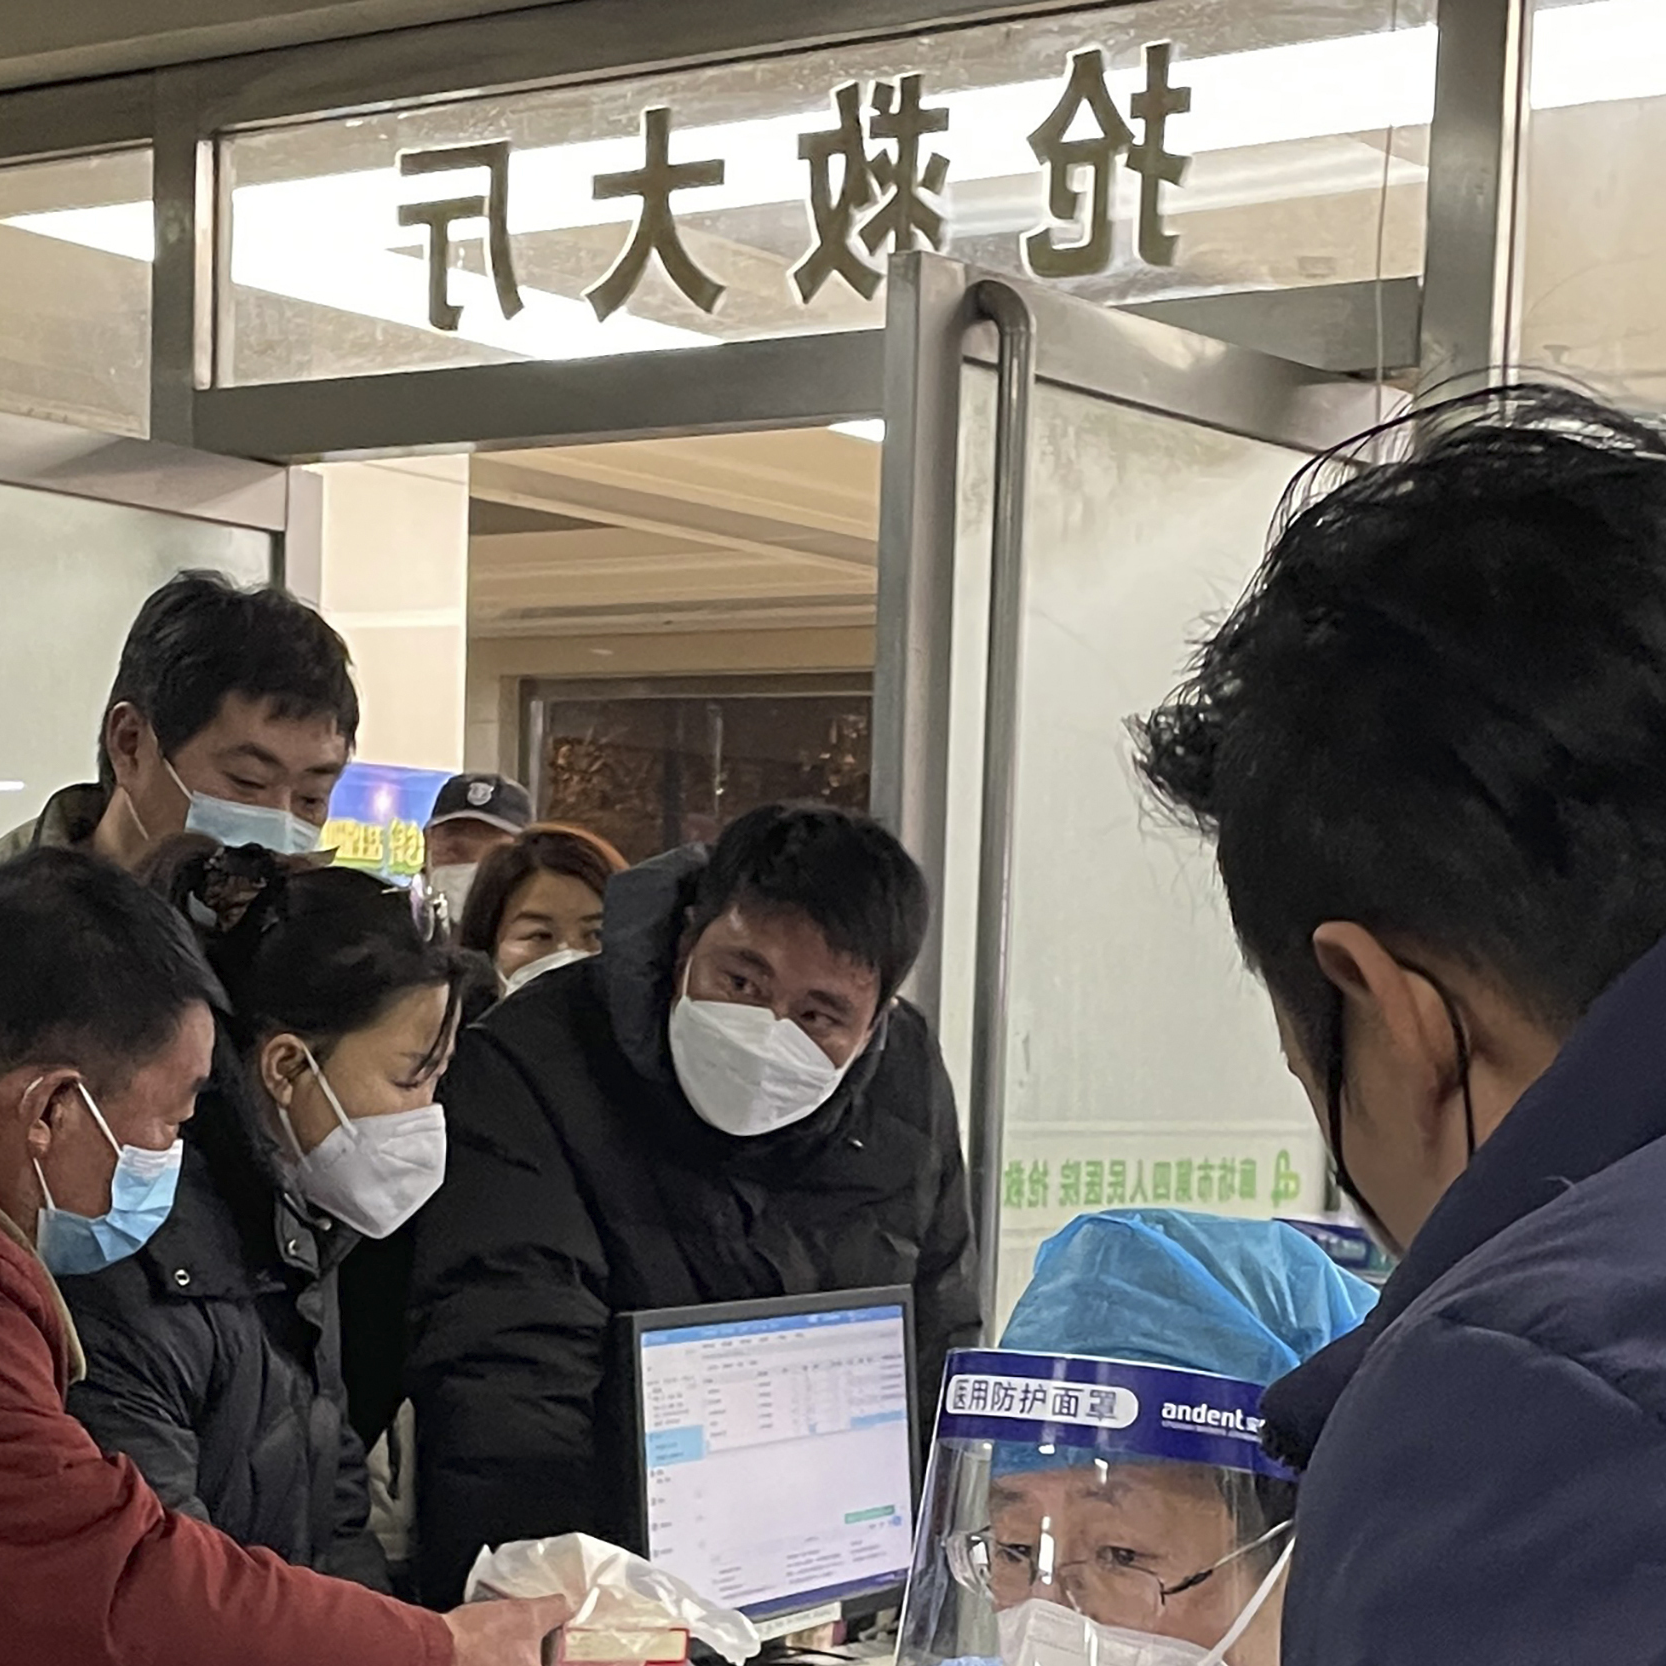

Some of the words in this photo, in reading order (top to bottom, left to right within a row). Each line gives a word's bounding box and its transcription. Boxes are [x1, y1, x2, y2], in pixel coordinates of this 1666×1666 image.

[953, 1378, 1118, 1421] 医用防护面罩
